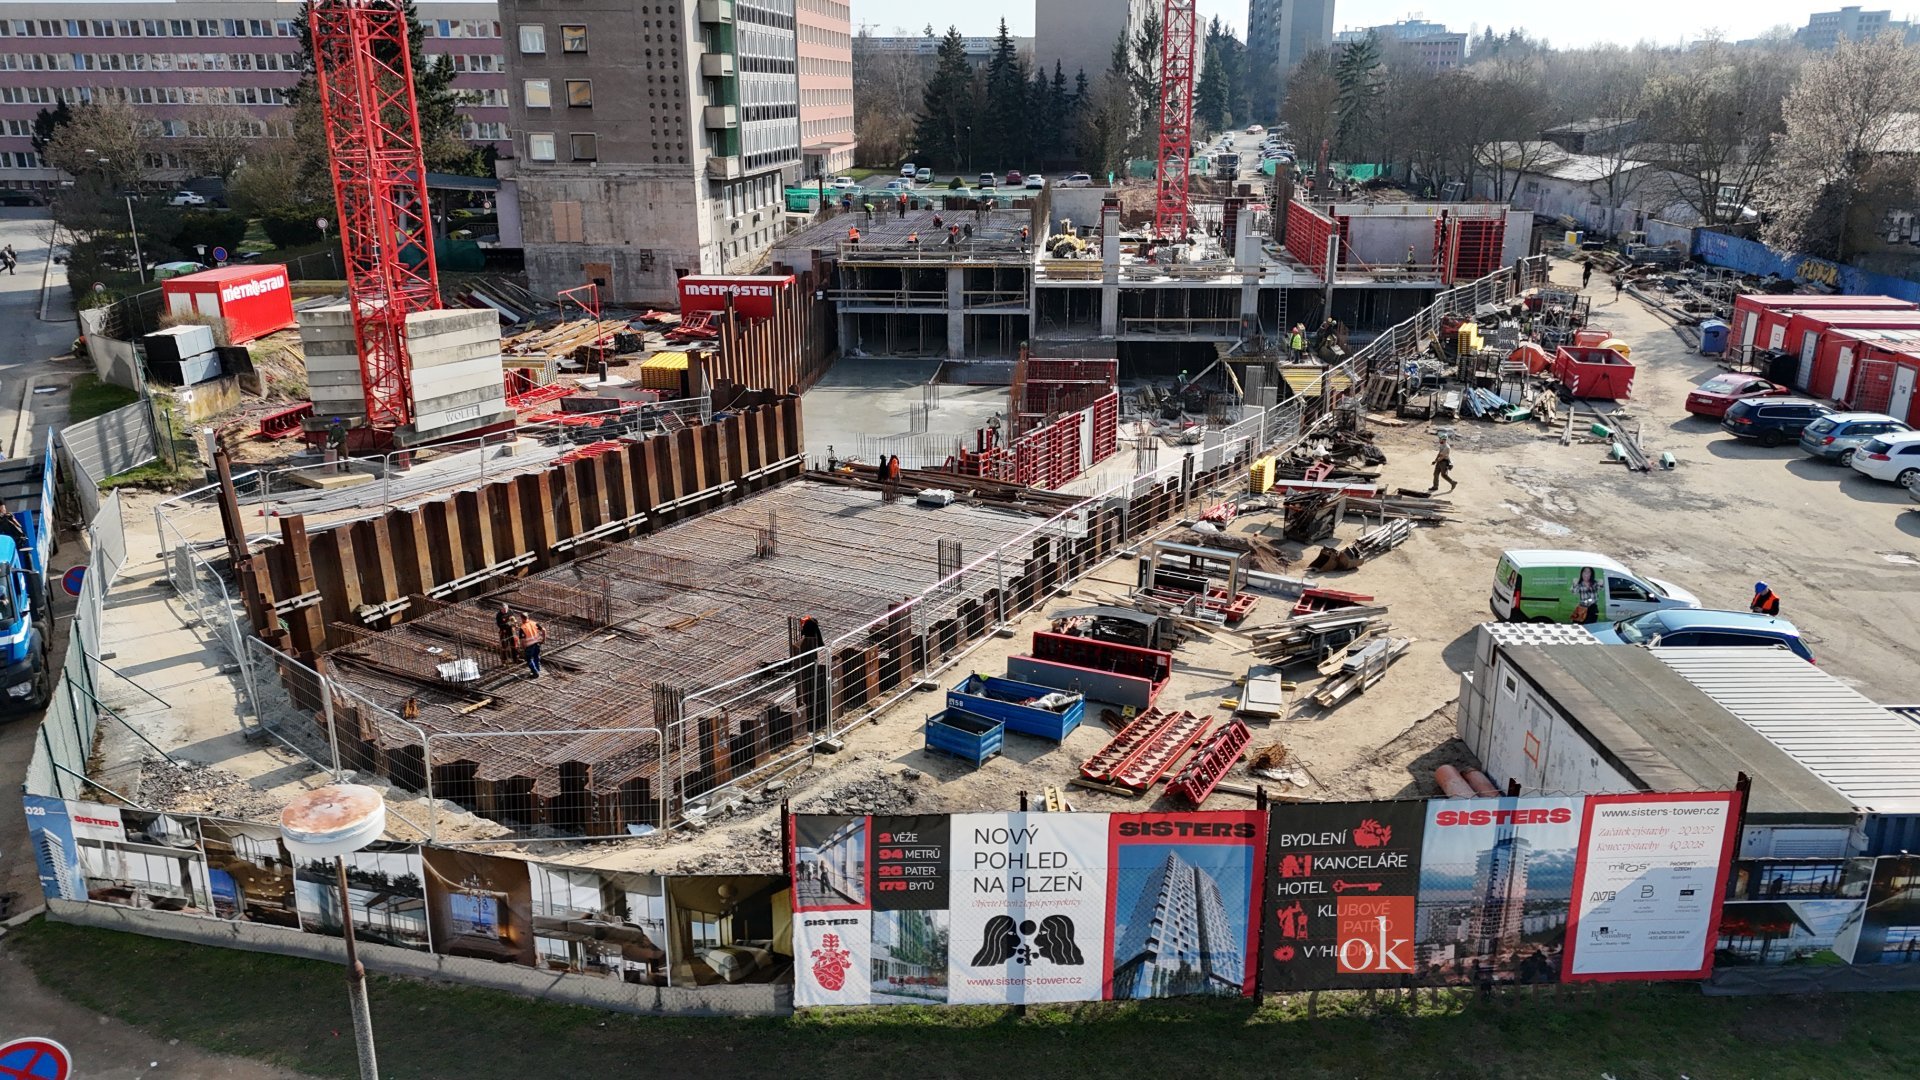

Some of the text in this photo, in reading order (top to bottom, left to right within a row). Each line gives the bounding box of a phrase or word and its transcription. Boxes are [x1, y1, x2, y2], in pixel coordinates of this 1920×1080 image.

[1436, 807, 1572, 827] SISTERS
[1602, 807, 1720, 818] www.sisters-tower.cz
[74, 815, 119, 827] SISTERS
[879, 832, 918, 843] 2 VĚŽE
[975, 824, 1039, 845] NOVÝ
[1119, 822, 1256, 838] SISTERS
[1280, 829, 1347, 847] BYDLENÍ
[905, 848, 940, 859] METRŮ
[975, 851, 1068, 869] POHLED
[1314, 852, 1408, 870] KANCELÁŘE
[905, 866, 936, 876] PATER
[909, 880, 935, 890] BYTŮ
[974, 871, 1083, 894] NA PLZEŇ
[1277, 881, 1328, 896] HOTEL
[1317, 899, 1391, 918] KLUBOVÉ
[804, 918, 859, 927] SISTERS
[966, 976, 1082, 986] www.sisters-tower.cz
